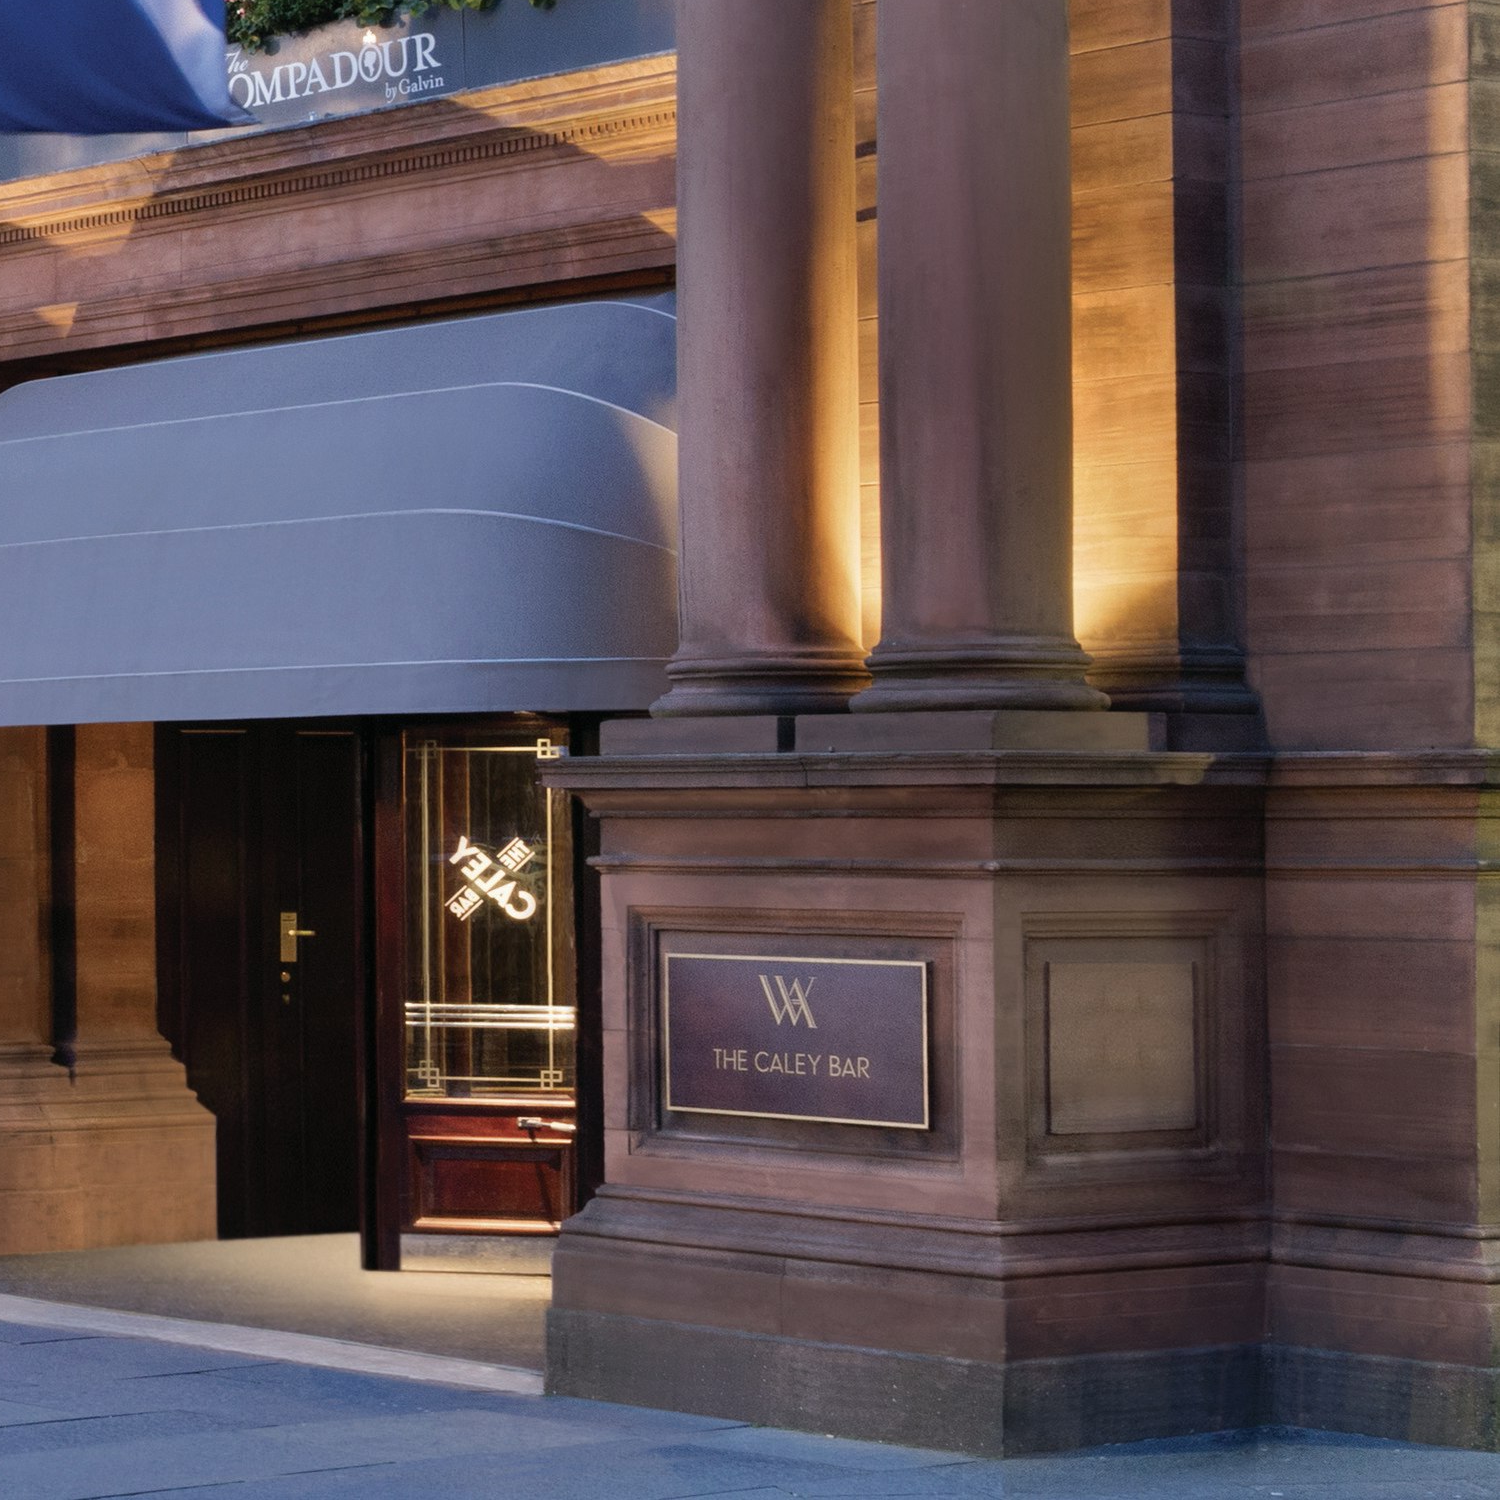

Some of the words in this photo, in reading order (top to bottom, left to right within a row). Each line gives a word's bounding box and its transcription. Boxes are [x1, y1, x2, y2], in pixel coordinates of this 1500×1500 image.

[228, 32, 442, 108] OMPADOUR
[385, 83, 397, 103] by
[398, 74, 445, 95] Galvin
[713, 1048, 748, 1071] THE
[754, 1051, 822, 1076] CALEY
[829, 1055, 870, 1079] BAR
